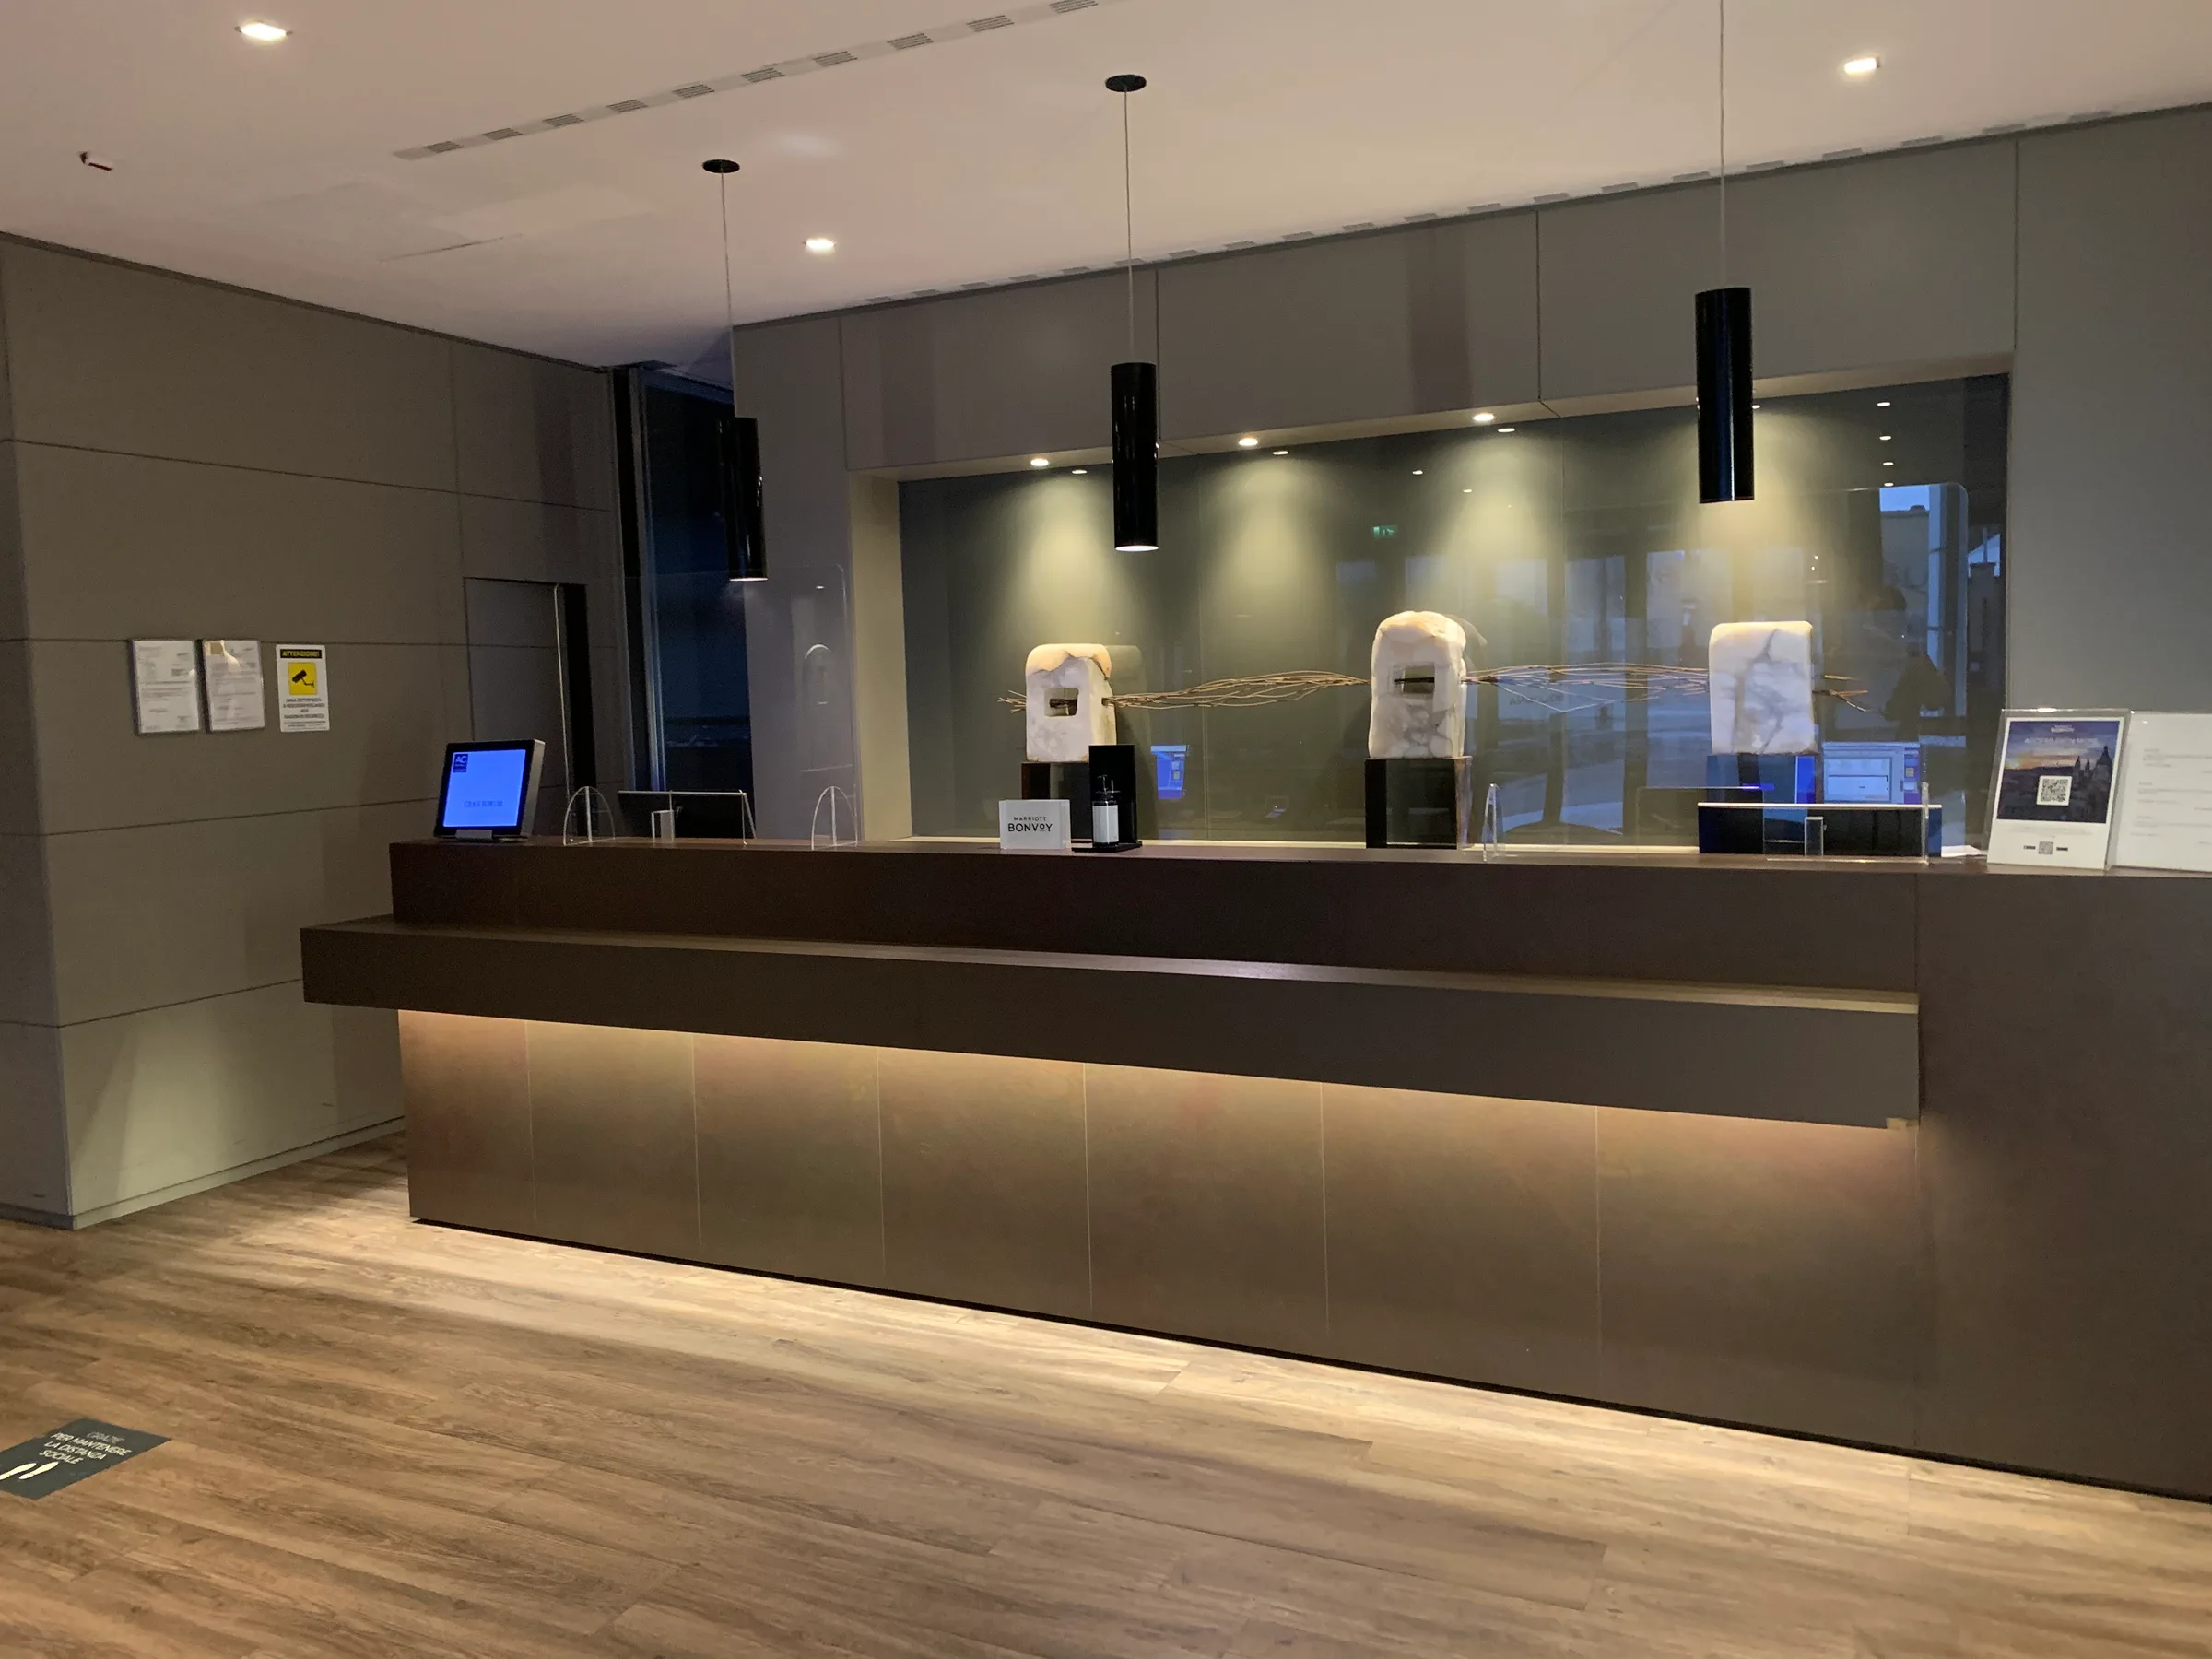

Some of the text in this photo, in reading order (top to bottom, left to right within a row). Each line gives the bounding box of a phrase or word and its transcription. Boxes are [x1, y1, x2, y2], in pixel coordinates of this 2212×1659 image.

[1007, 823, 1053, 832] BONVOY
[51, 1432, 132, 1456] PER MANTENERE
[39, 1450, 84, 1464] SOCIALE
[57, 1444, 107, 1460] DISTANZA
